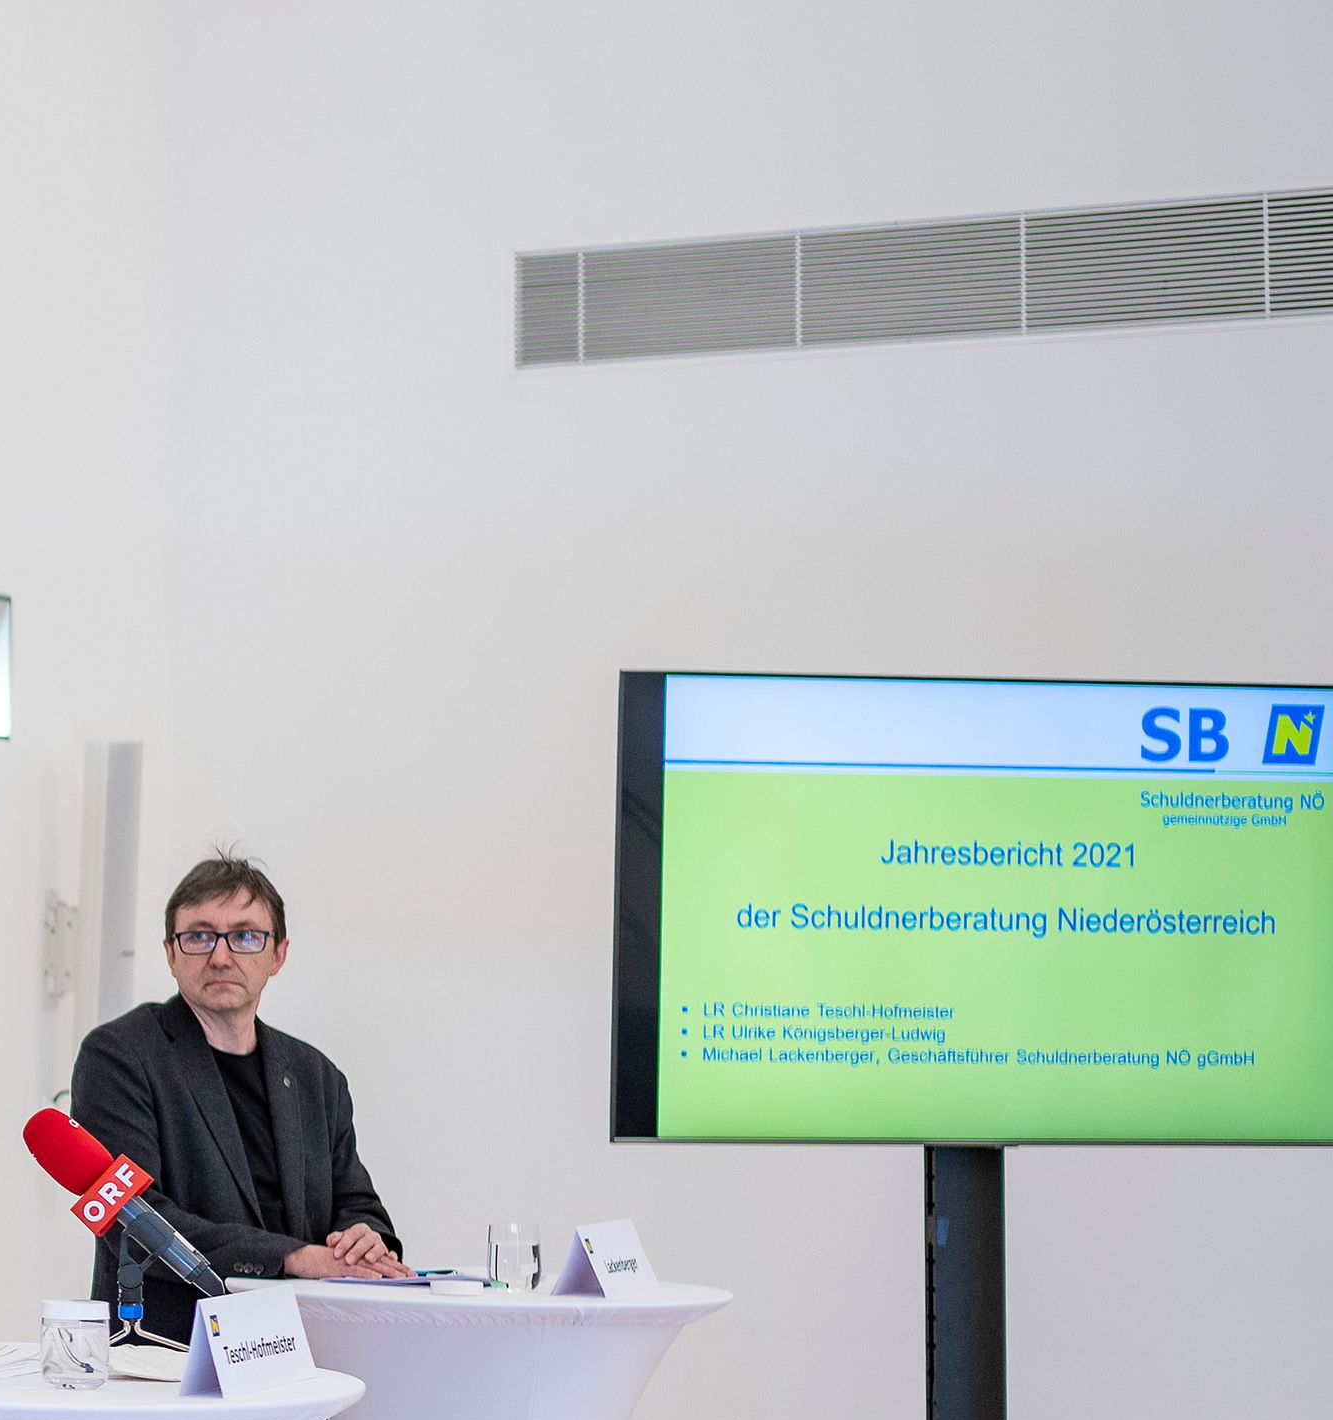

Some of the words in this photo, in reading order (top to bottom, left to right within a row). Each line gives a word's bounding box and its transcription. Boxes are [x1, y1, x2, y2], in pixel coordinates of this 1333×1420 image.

[1140, 706, 1230, 762] SB
[1140, 790, 1294, 814] Schuldnerberatung
[1300, 790, 1325, 811] NÖ
[1162, 813, 1247, 829] gemeinnützige
[1251, 814, 1287, 827] GmbH
[881, 838, 1063, 867] Jahresbericht
[1072, 841, 1135, 868] 2021
[736, 903, 781, 929] der
[790, 903, 1047, 939] Schuldnerberatung
[1058, 906, 1276, 935] Niederösterreich
[703, 1001, 725, 1017] LR
[732, 1002, 810, 1018] Christiane
[817, 1003, 955, 1021] Teschl-Hofmeister
[703, 1024, 725, 1040] LR
[732, 1024, 776, 1041] Ulrike
[783, 1025, 946, 1044] Königsberger-Ludwig
[702, 1047, 762, 1063] Michael
[769, 1048, 880, 1067] Lackenberger,
[888, 1048, 1009, 1065] Geschäftsführer
[1016, 1049, 1160, 1069] Schuldnerberatung
[1166, 1047, 1191, 1066] NÖ
[1197, 1051, 1255, 1070] gGmbH
[83, 1162, 135, 1222] ORF
[222, 1336, 297, 1365] Teschl-Hofmeister
